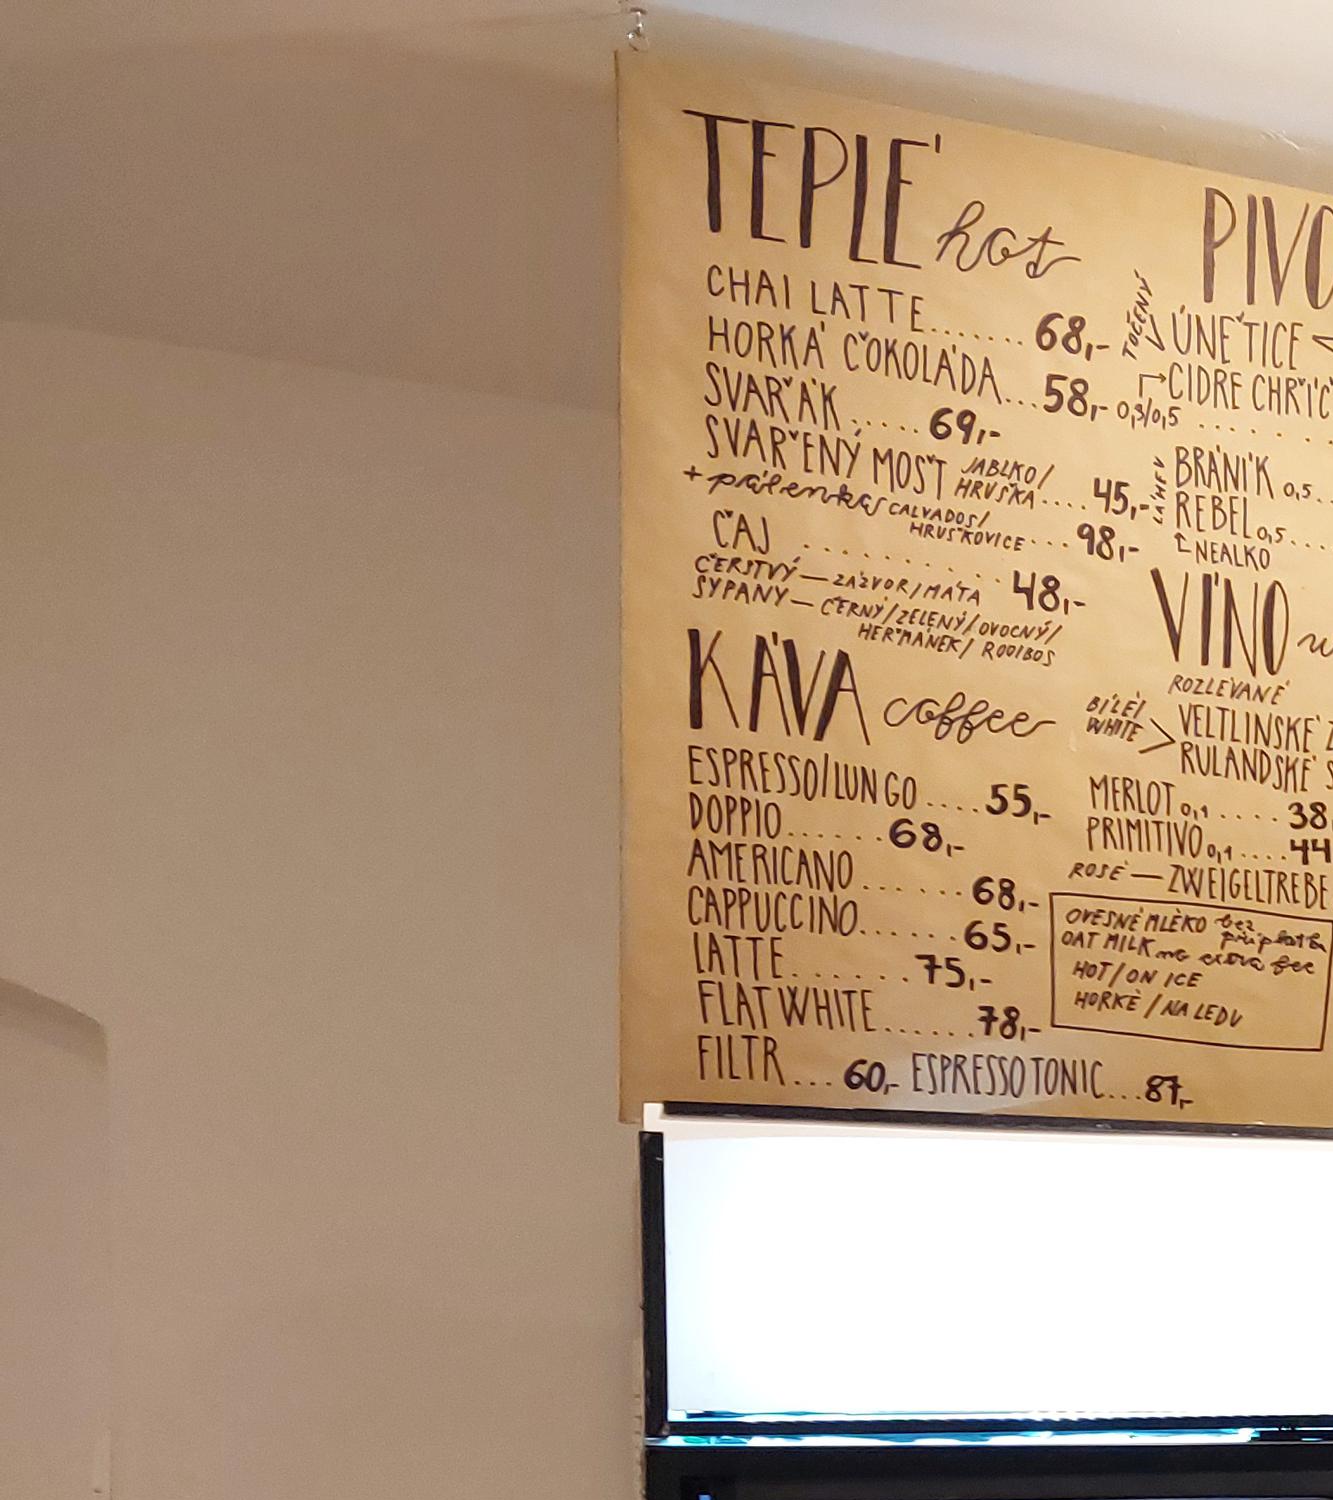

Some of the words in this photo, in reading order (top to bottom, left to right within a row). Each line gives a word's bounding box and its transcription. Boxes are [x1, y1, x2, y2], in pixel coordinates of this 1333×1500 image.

[682, 110, 941, 269] TEPLÉ
[936, 201, 1081, 279] hot
[707, 265, 790, 309] CHAI
[811, 280, 924, 338] LATTE
[1036, 313, 1110, 361] 68,-
[1172, 305, 1303, 370] ÚNĚTICE
[709, 315, 825, 370] HORKÁ
[844, 328, 1002, 405] ČOKOLÁDA
[1043, 374, 1108, 422] 58,-
[1169, 362, 1242, 409] CIDRE
[704, 361, 840, 431] SVAŘÁK
[929, 408, 1000, 445] 69,-
[706, 414, 861, 483] SVAŘENÝ
[873, 448, 947, 500] MOŠT
[713, 509, 769, 555] ČAJ
[1176, 491, 1252, 539] REBEL
[1196, 539, 1270, 571] NEALKO
[1013, 570, 1086, 615] 48,-
[1150, 567, 1289, 678] VÍNO
[687, 623, 876, 746] KÁVA
[884, 692, 1056, 744] coffee
[689, 792, 781, 839] DOPPIO
[889, 818, 965, 857] 68,-
[985, 784, 1051, 825] 55,-
[1089, 775, 1176, 816] MERLOT
[1087, 811, 1202, 858] PRIMITIVO
[687, 835, 853, 892] AMERICANO
[972, 876, 1039, 913] 68,-
[1168, 864, 1328, 913] ZWEIGELTREBE
[688, 885, 858, 936] CAPPUCCINO
[964, 920, 1036, 955] 65,-
[1061, 931, 1100, 948] OAT
[1103, 933, 1156, 957] MILK
[694, 932, 783, 981] LATTE
[914, 954, 992, 991] 75,-
[1164, 972, 1203, 988] ICE
[698, 980, 771, 1030] FLAT
[778, 986, 876, 1032] WHITE
[977, 1006, 1041, 1041] 78,-
[1193, 1003, 1243, 1027] LEDU
[698, 1034, 785, 1086] FILTR
[844, 1059, 899, 1095] 60,-
[912, 1052, 1025, 1098] ESPRESSO
[1030, 1057, 1105, 1099] TONIC
[1145, 1075, 1194, 1110] 87,-
